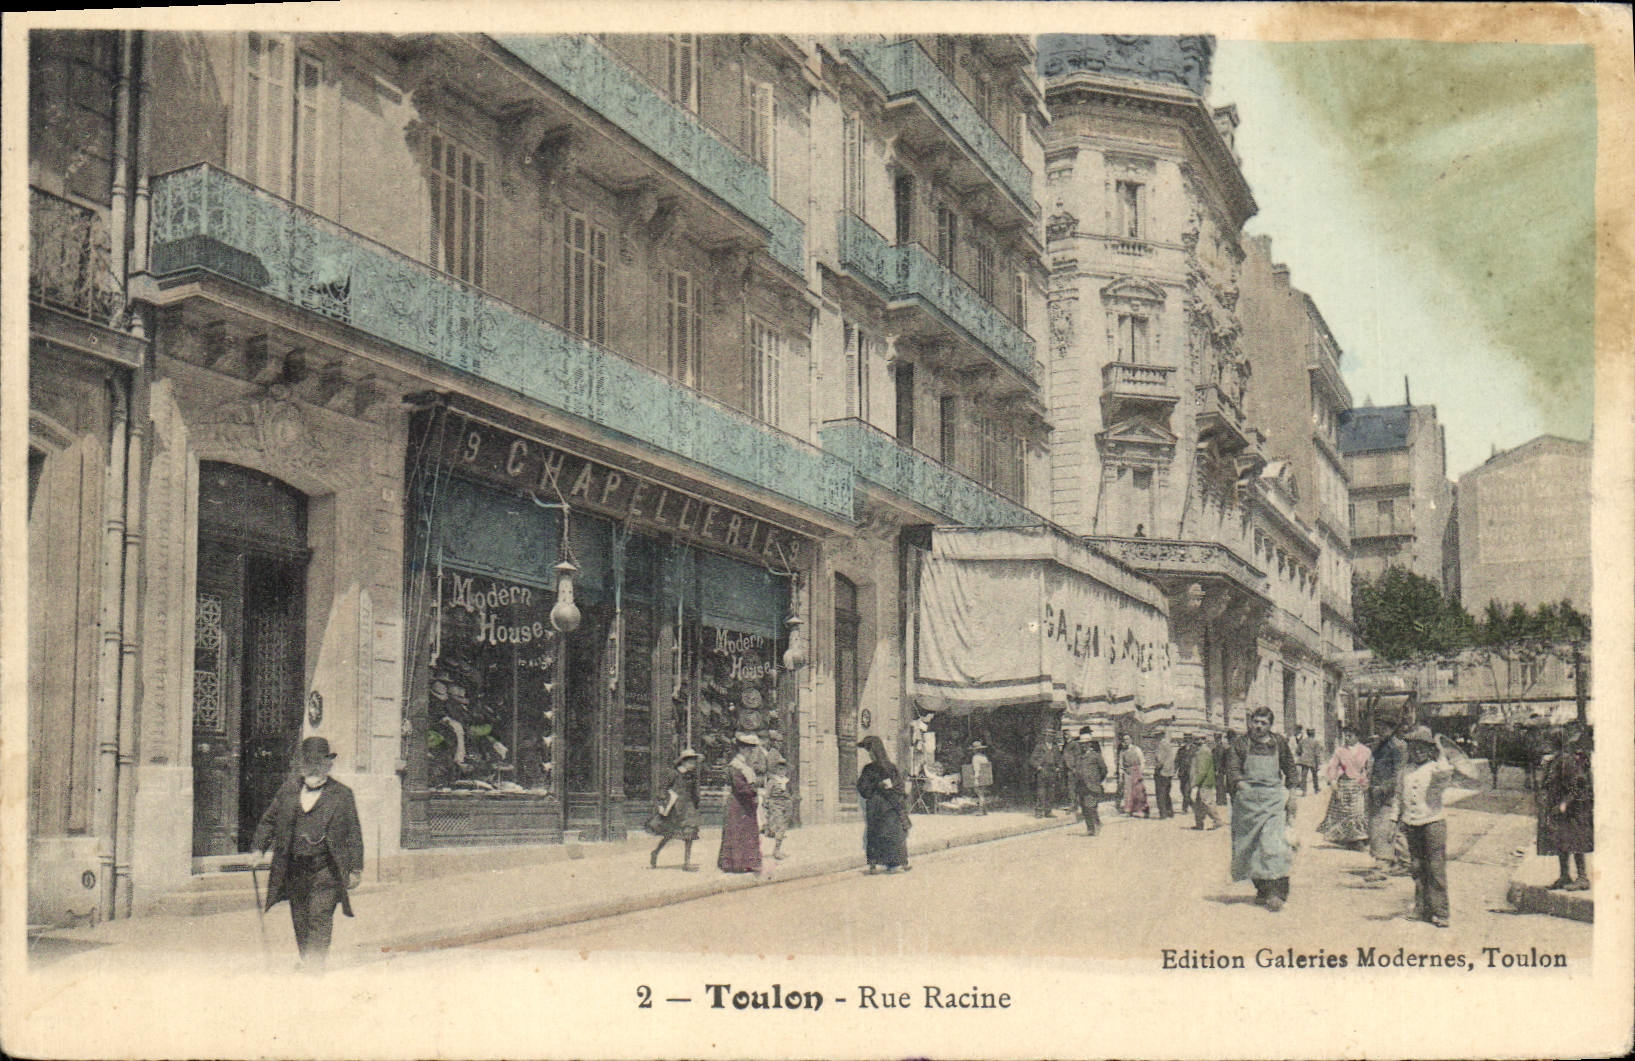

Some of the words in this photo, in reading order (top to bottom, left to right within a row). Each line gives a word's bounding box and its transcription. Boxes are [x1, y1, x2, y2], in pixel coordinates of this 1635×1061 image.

[463, 431, 481, 463] 9
[506, 440, 776, 558] CHAPELLERIE
[450, 572, 532, 613] Modern
[475, 610, 544, 646] House
[713, 626, 764, 657] Modern
[729, 653, 772, 681] House
